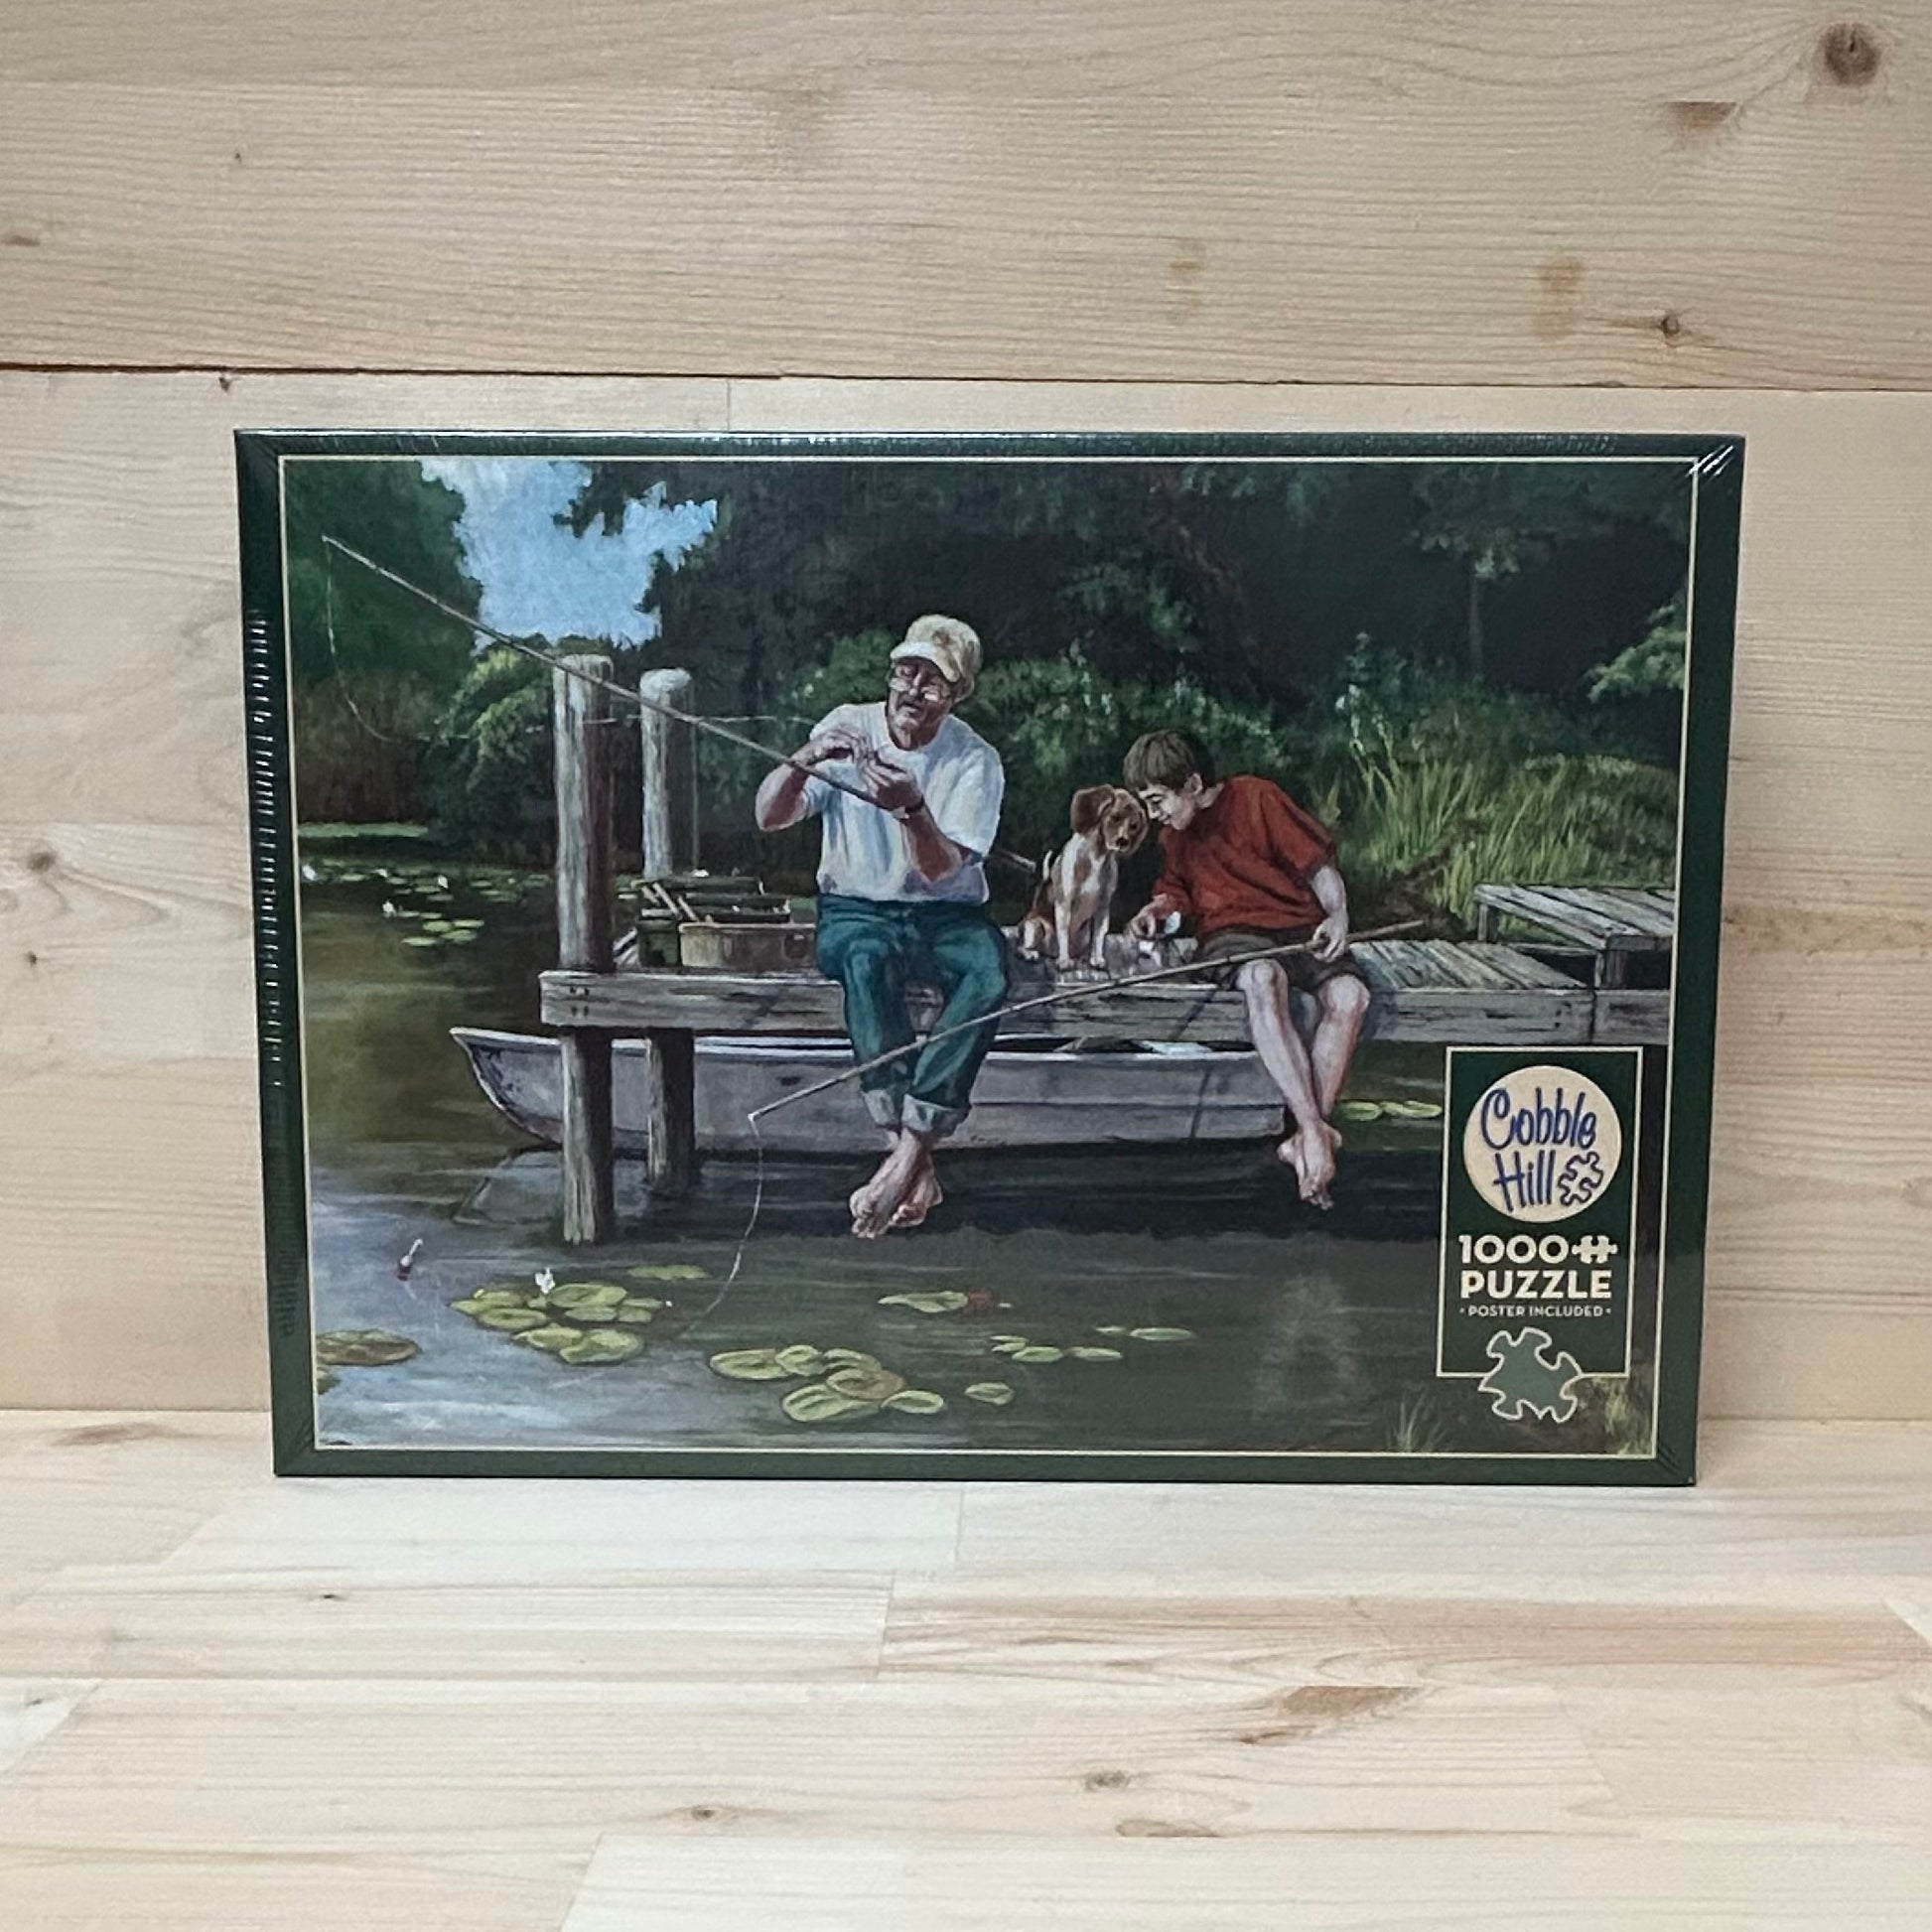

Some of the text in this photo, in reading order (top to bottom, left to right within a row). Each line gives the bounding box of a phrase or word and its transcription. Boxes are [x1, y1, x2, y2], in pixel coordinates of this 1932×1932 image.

[1480, 1087, 1596, 1150] Cobble
[1493, 1150, 1556, 1212] Hill
[1458, 1234, 1570, 1265] 1000
[1460, 1270, 1612, 1300] PUZZLE
[1467, 1305, 1603, 1317] POSTER INCLUDED
